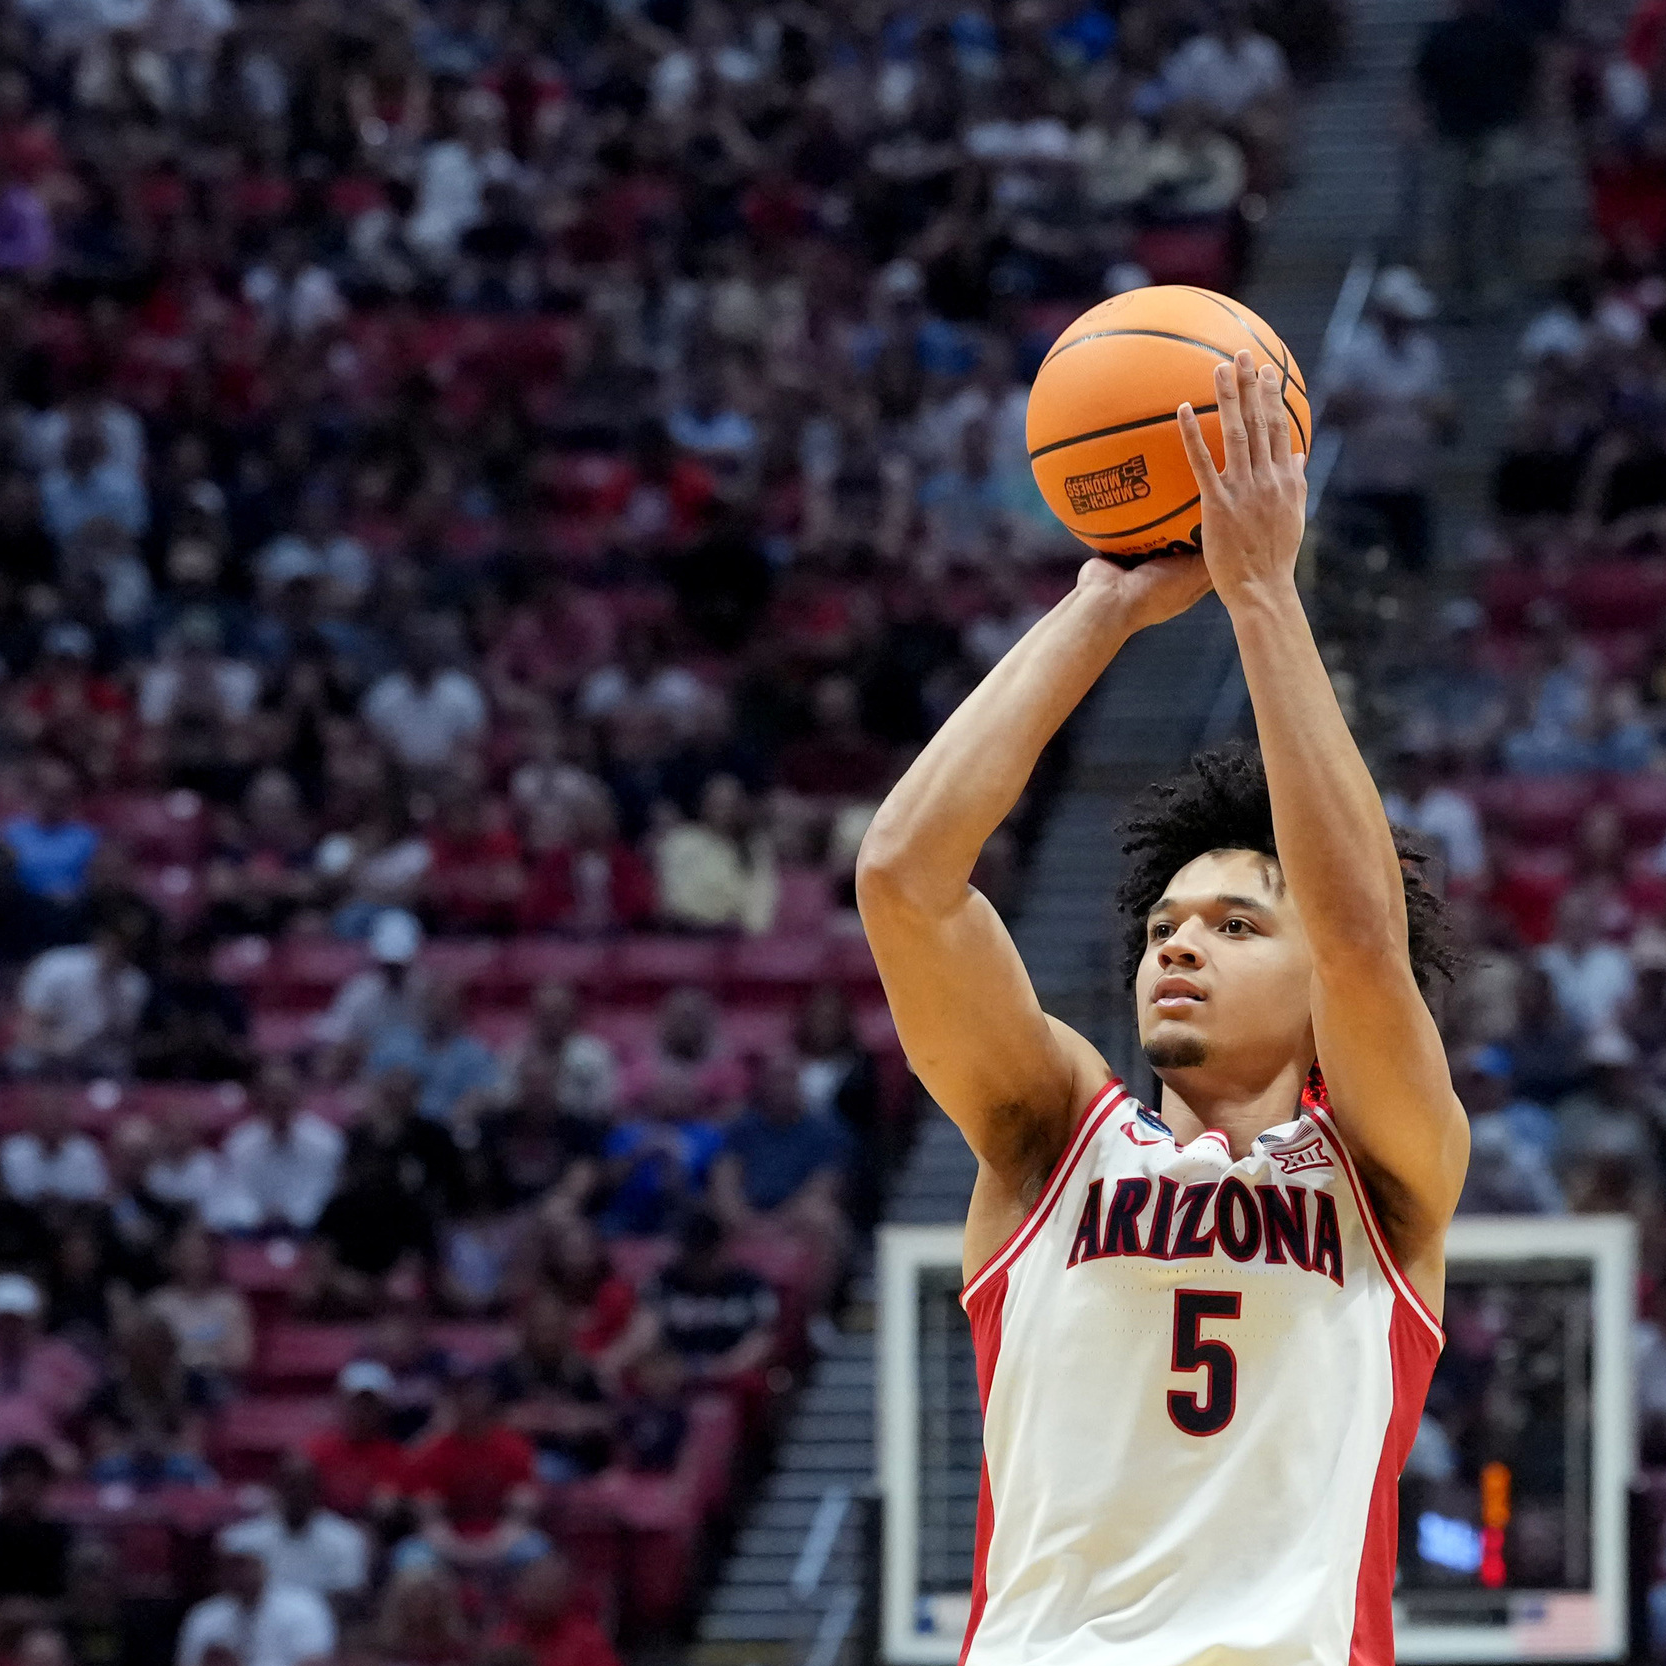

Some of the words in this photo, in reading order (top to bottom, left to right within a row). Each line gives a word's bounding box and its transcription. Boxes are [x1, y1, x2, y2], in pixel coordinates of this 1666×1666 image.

[1066, 470, 1122, 498] MADNESS
[1089, 486, 1135, 509] MARCH
[1066, 1175, 1345, 1288] ARIZONA
[1167, 1288, 1242, 1437] 5
